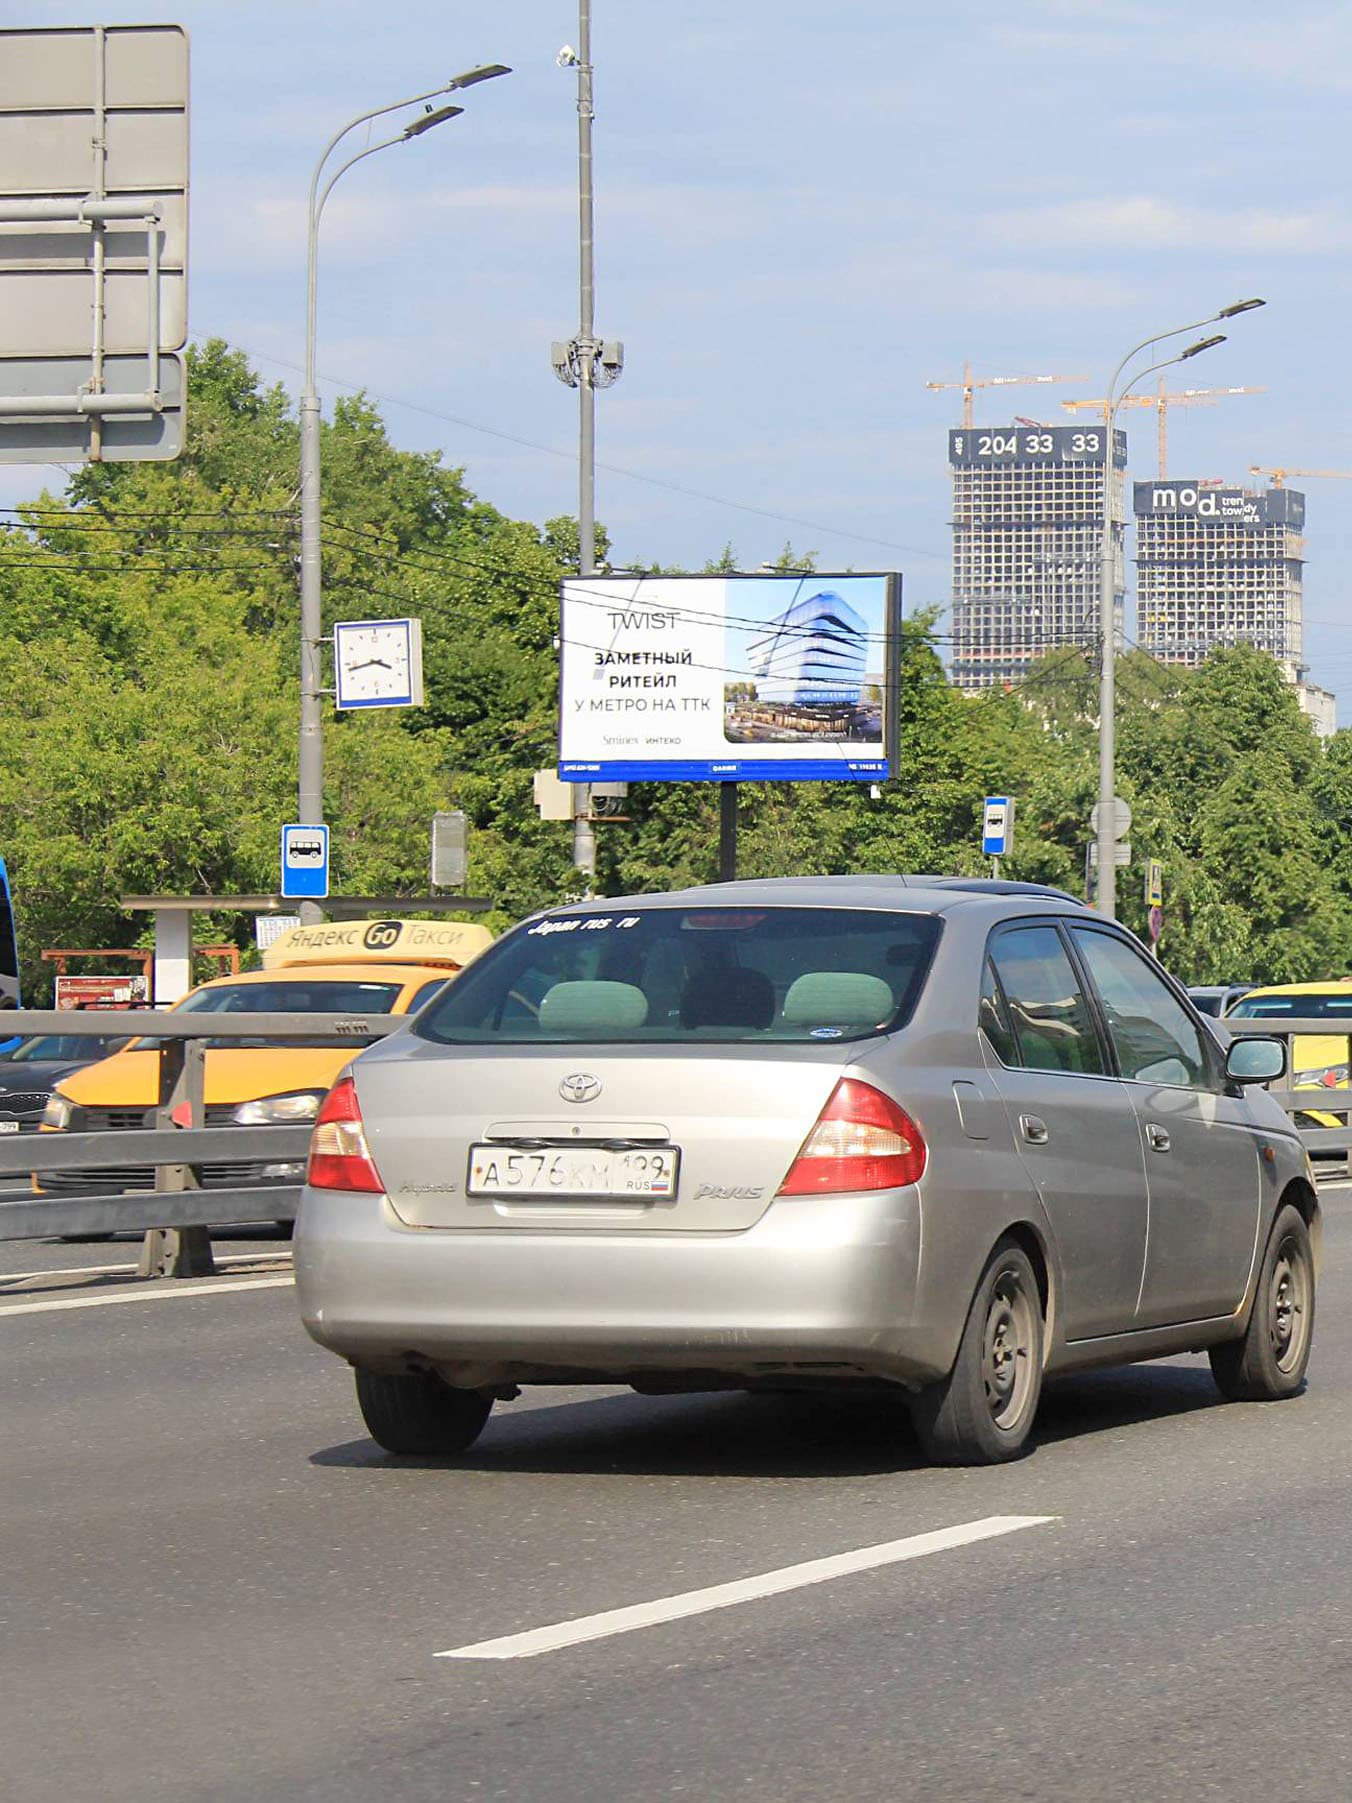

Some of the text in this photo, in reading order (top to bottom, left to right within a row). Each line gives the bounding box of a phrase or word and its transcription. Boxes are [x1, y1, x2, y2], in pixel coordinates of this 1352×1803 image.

[978, 436, 1017, 455] 204
[1025, 435, 1053, 454] 33
[1071, 434, 1100, 452] 33
[607, 612, 681, 629] TWIST
[594, 648, 692, 665] ЗАМЕТНЫЙ
[609, 672, 677, 688] РИТЕЙЛ
[574, 698, 711, 712] У МЕТРО НА ТТК
[286, 929, 362, 948] Яндекс
[366, 923, 399, 946] Go
[405, 924, 465, 945] Такси
[627, 1180, 650, 1192] RUS
